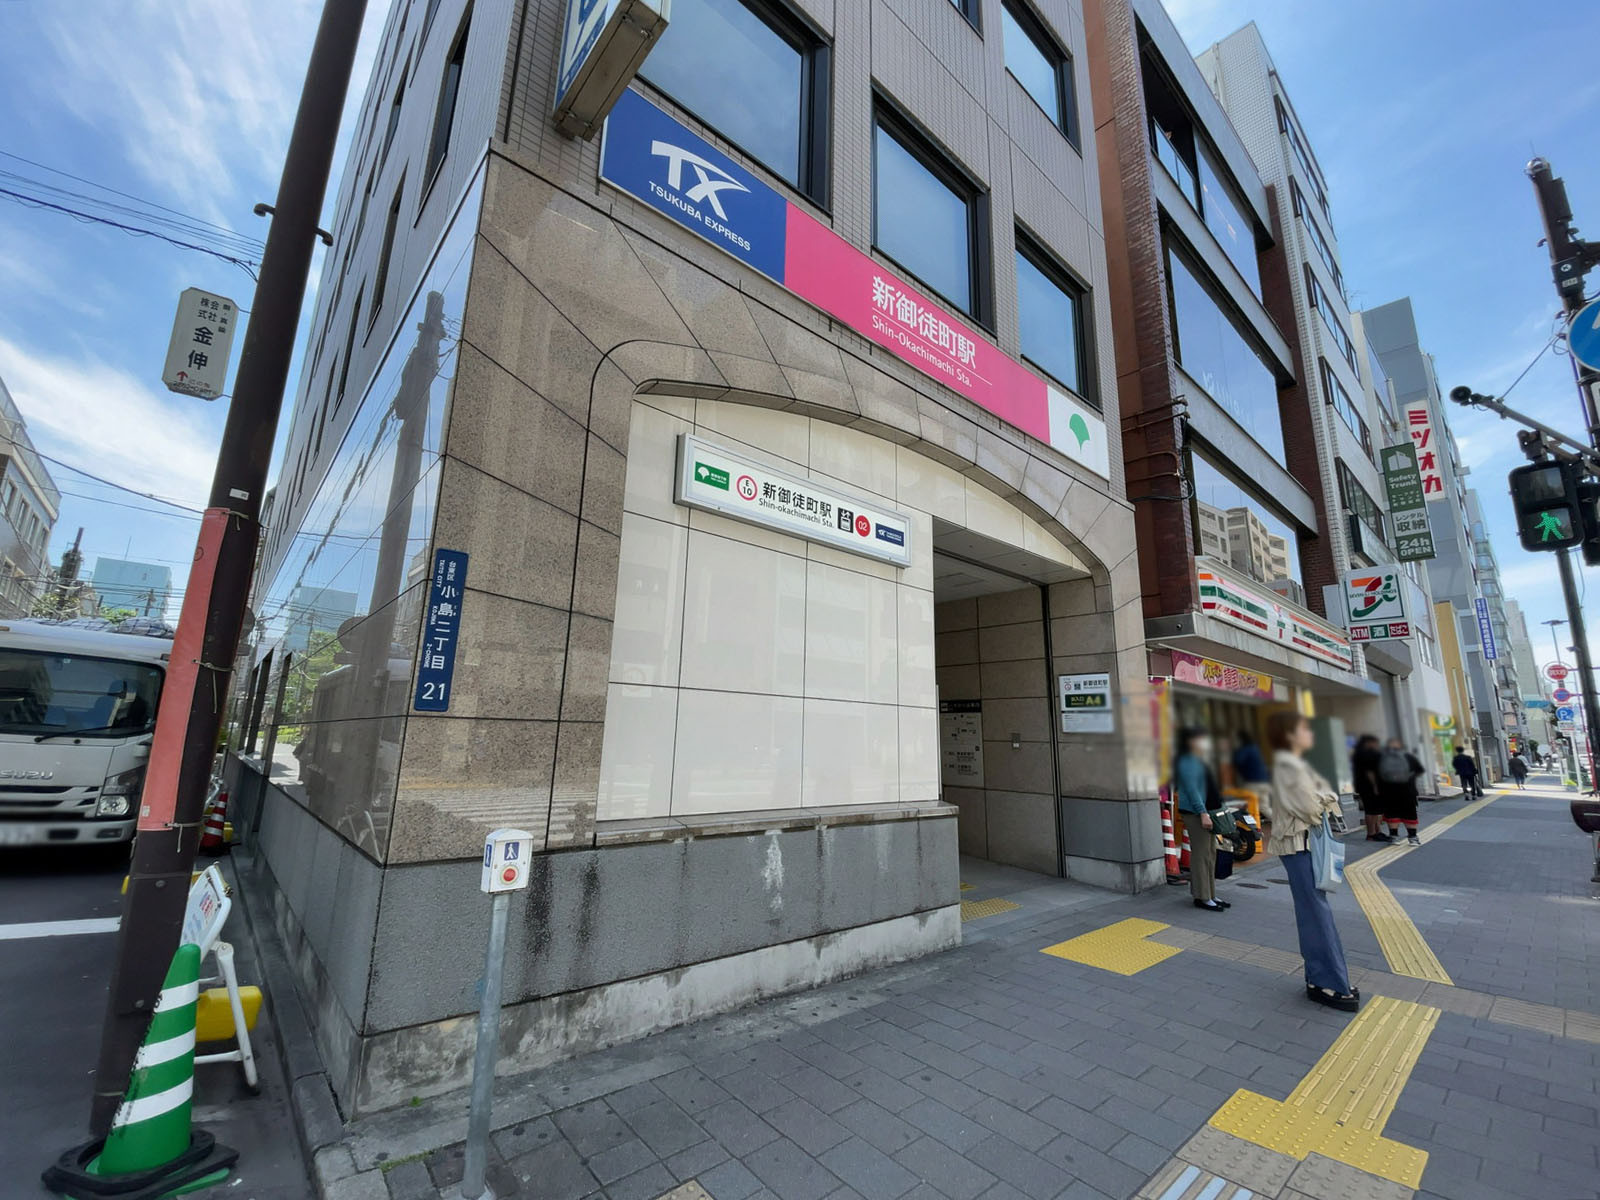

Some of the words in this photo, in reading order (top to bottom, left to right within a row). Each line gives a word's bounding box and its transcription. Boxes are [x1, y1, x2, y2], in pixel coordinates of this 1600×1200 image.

[651, 140, 751, 222] TX
[649, 181, 702, 221] TSUKUBA
[705, 216, 751, 251] EXPRESS
[872, 275, 976, 369] 新御徒町駅
[188, 326, 214, 370] 金伸
[872, 315, 954, 376] Shin-Okachimachi
[956, 368, 973, 387] Sta.
[1408, 410, 1444, 494] ミツオカ
[1389, 474, 1417, 483] Safety
[1390, 481, 1417, 490] Trunk
[743, 486, 752, 496] 10
[763, 481, 832, 519] 新御徒町駅
[759, 498, 821, 525] Shin-okachimachi
[822, 518, 834, 529] Sta.
[1396, 512, 1425, 522] レンタル
[858, 521, 867, 532] 02
[1397, 519, 1426, 533] 収納
[1400, 537, 1430, 549] 24h
[1401, 546, 1432, 556] OPEN
[431, 585, 456, 670] 小島二丁目
[1352, 628, 1369, 639] ATM
[1373, 626, 1386, 637] 酒
[422, 682, 446, 701] 21
[1085, 695, 1101, 705] A4
